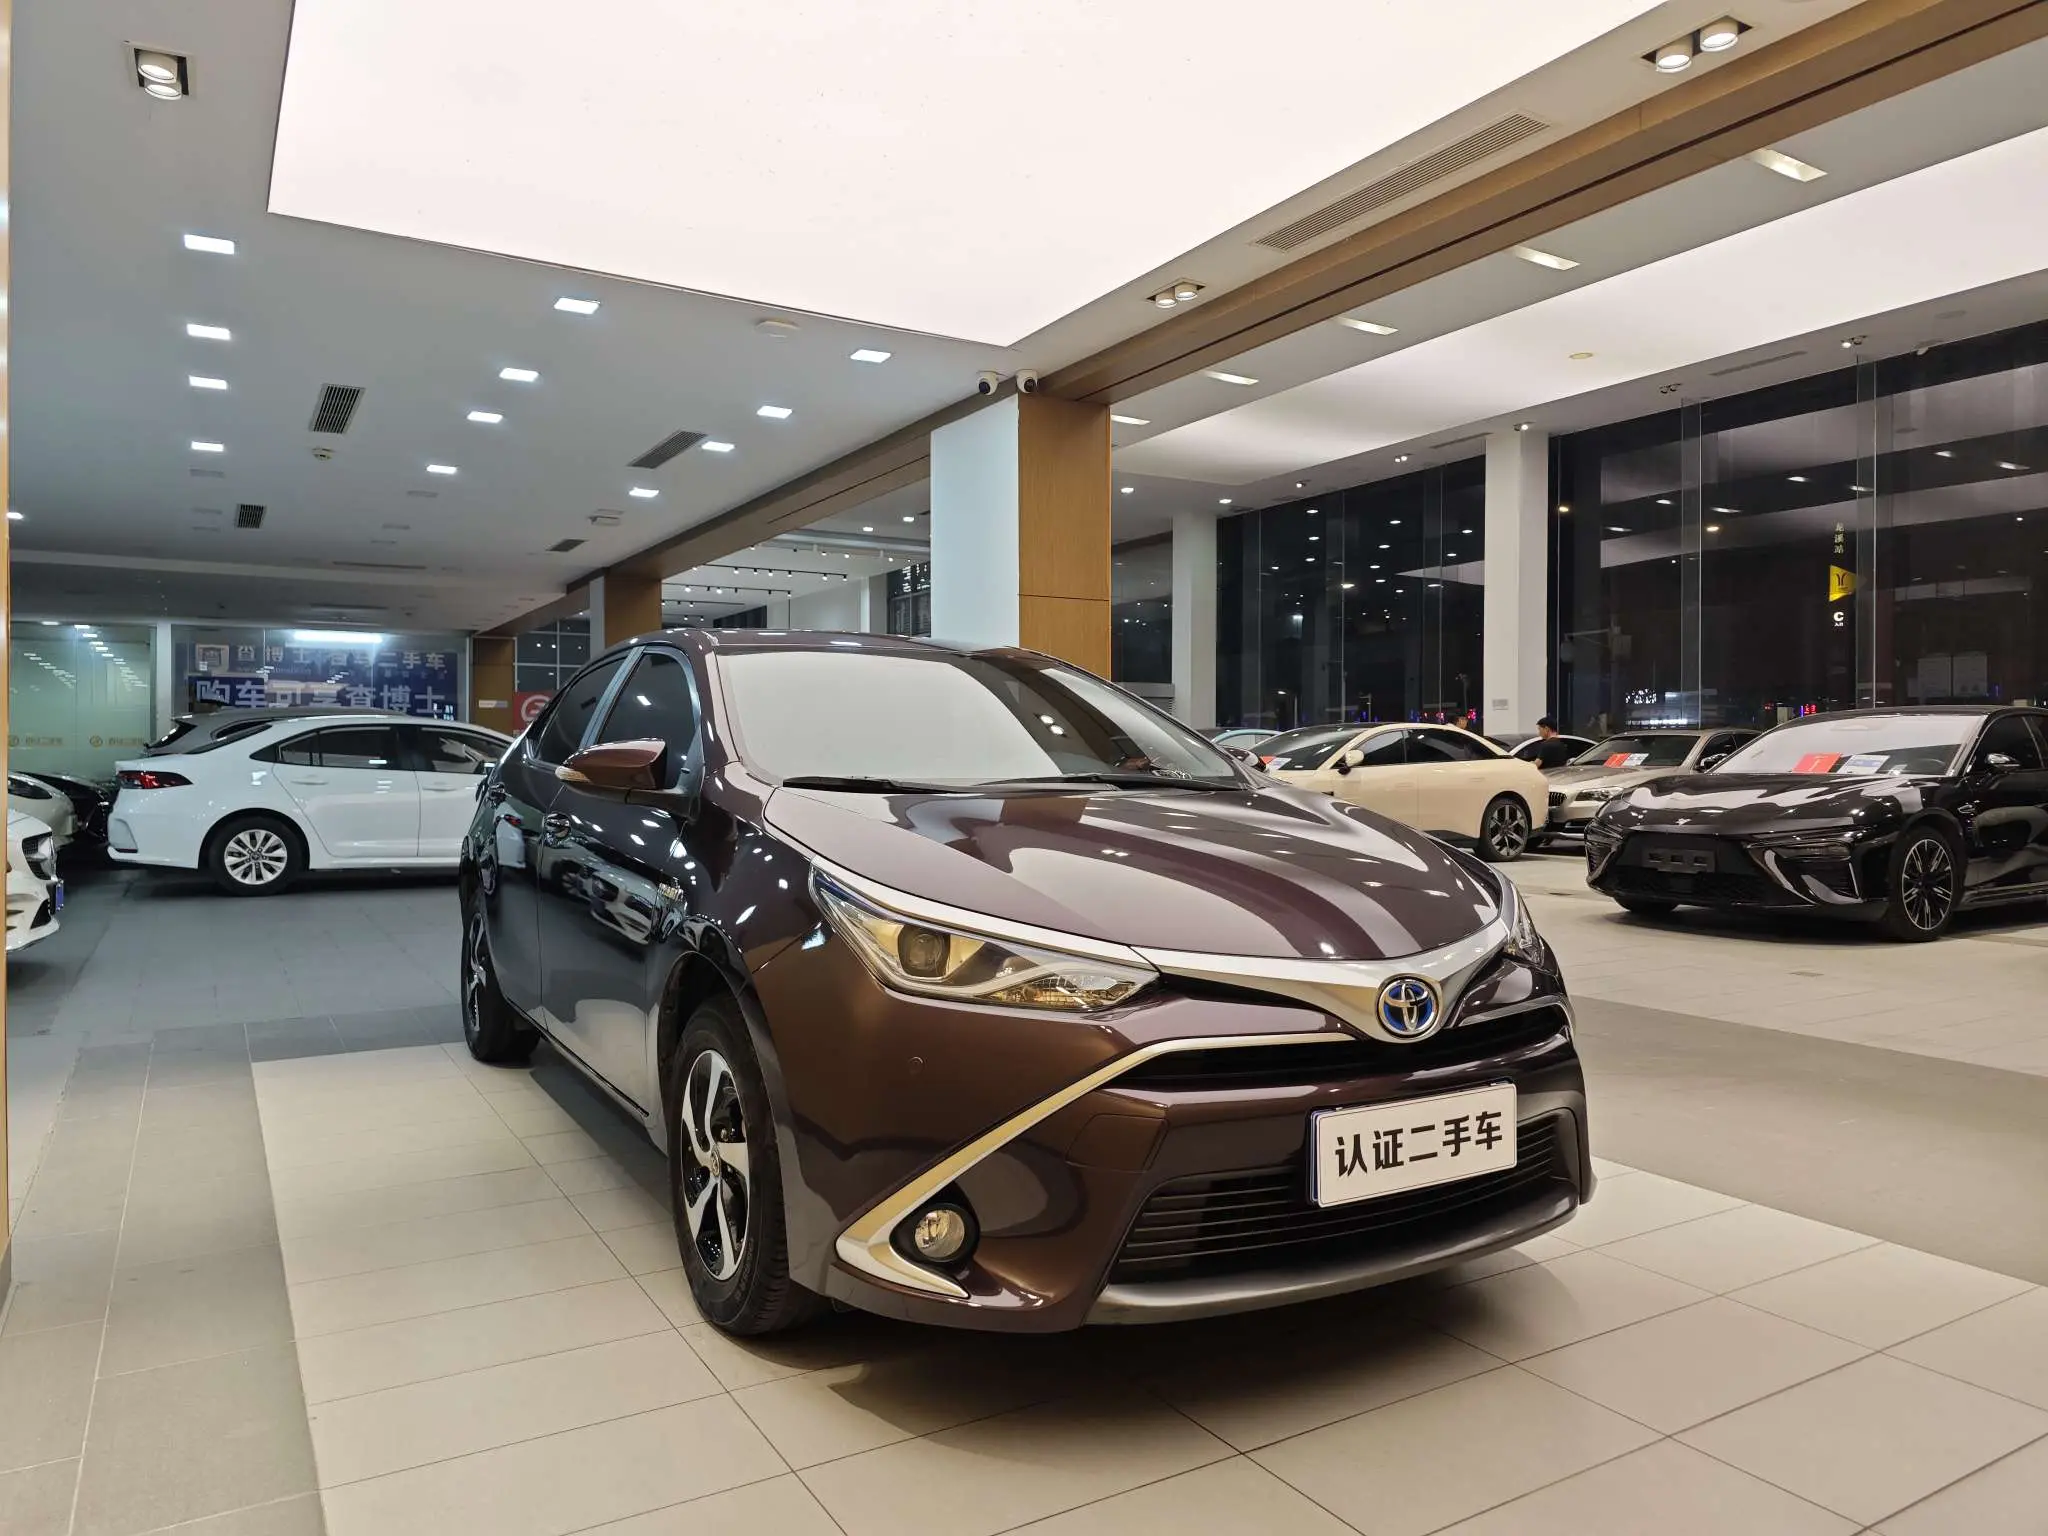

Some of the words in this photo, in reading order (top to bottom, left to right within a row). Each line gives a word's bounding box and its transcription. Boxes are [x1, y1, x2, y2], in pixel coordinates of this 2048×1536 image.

[1334, 1110, 1503, 1177] 认证二手车
